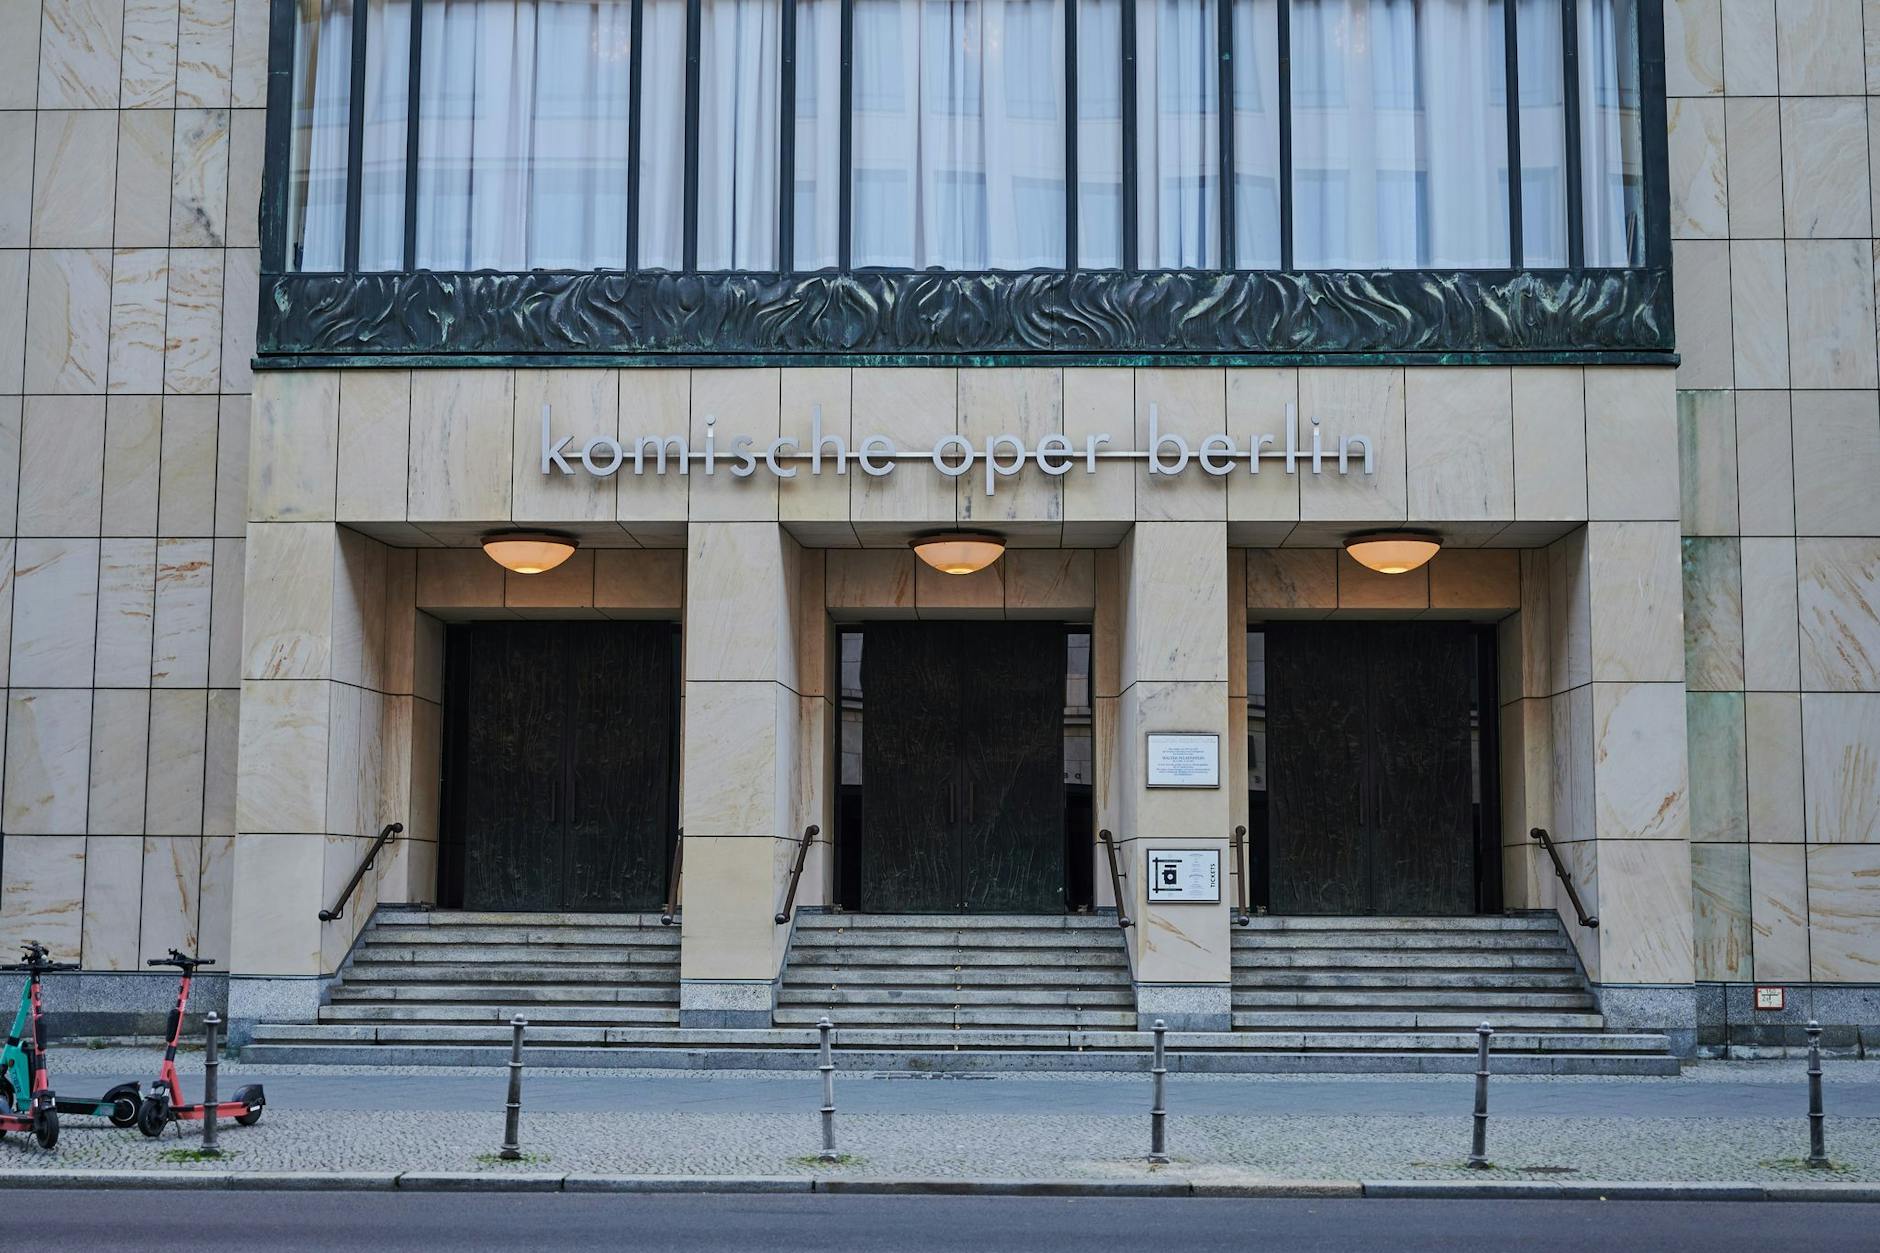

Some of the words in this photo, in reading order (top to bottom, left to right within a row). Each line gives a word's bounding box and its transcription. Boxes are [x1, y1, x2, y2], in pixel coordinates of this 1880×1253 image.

[541, 404, 895, 477] komische
[932, 433, 1111, 496] oper
[1149, 402, 1373, 476] berlin
